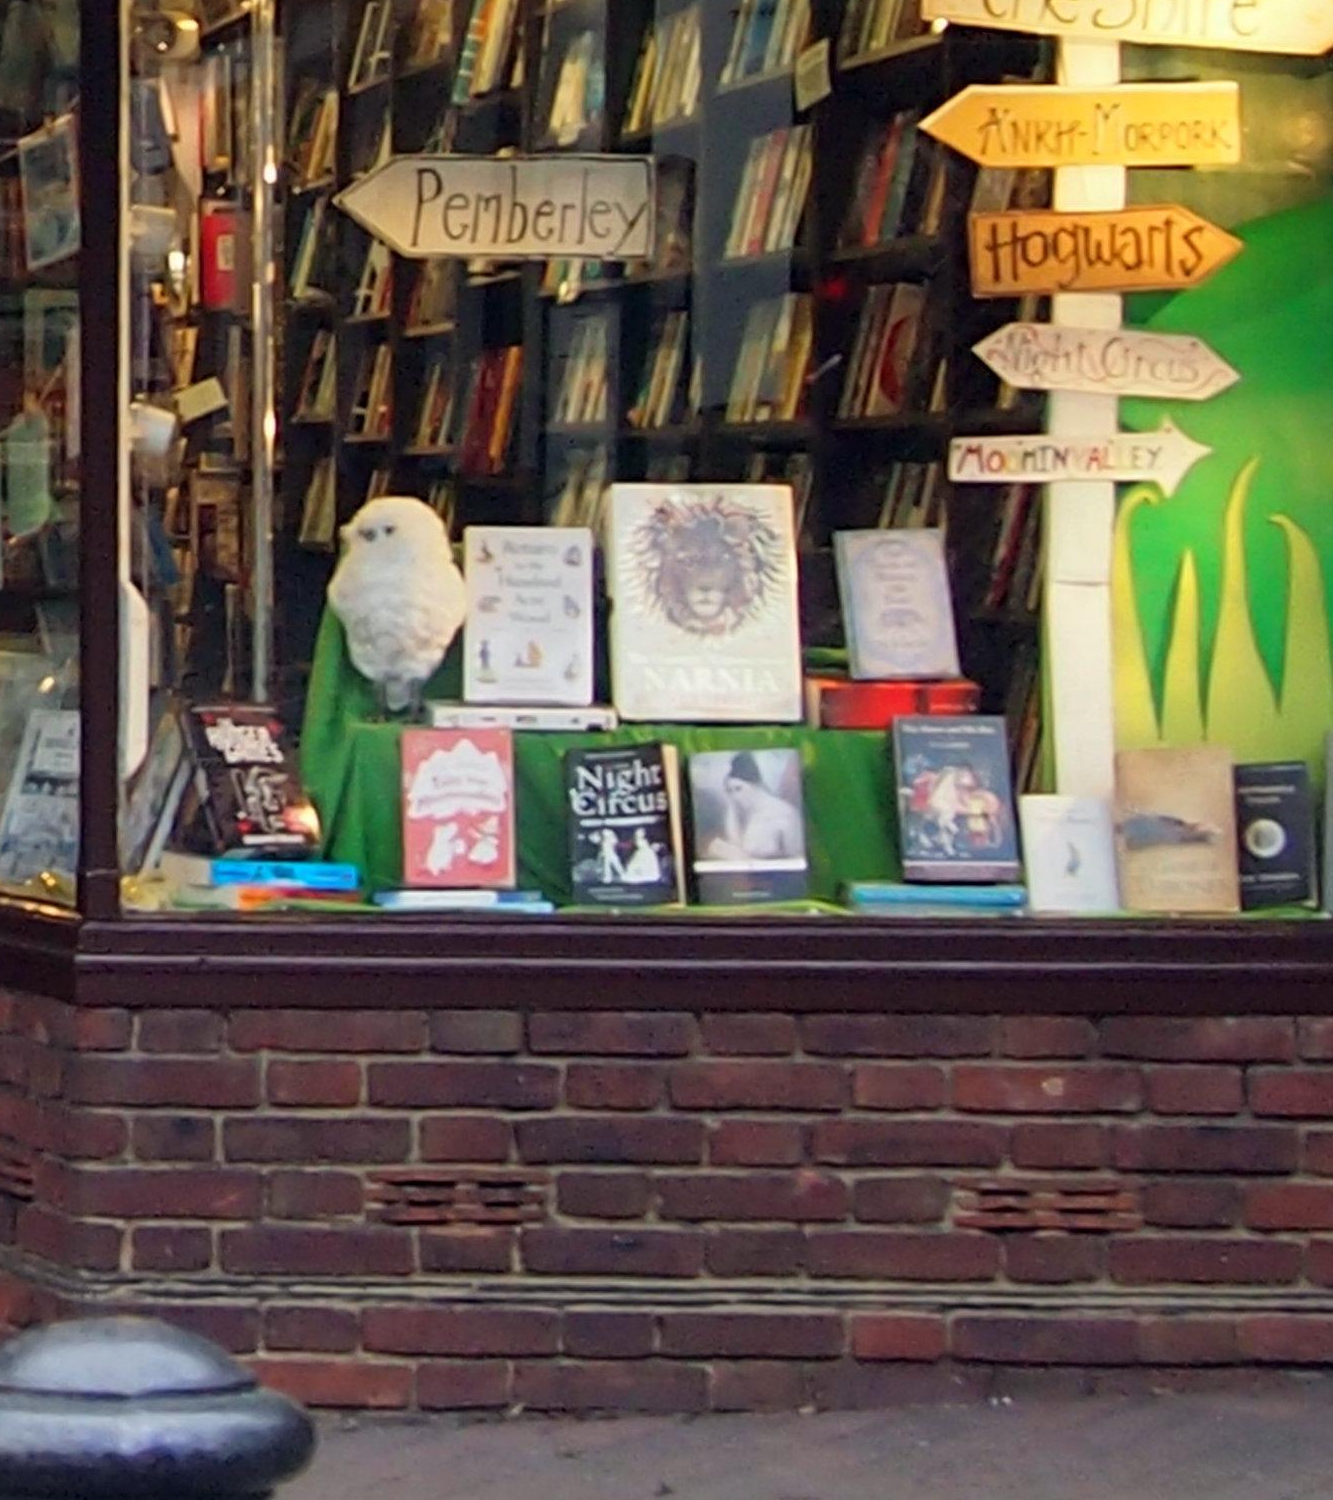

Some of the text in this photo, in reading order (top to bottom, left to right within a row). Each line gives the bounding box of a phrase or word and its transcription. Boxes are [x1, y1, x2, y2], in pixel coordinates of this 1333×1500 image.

[410, 164, 649, 257] Pemberley
[984, 217, 1208, 289] Hogwarts
[643, 666, 780, 694] NARNIA
[574, 758, 663, 796] Night
[568, 786, 669, 818] Circus
